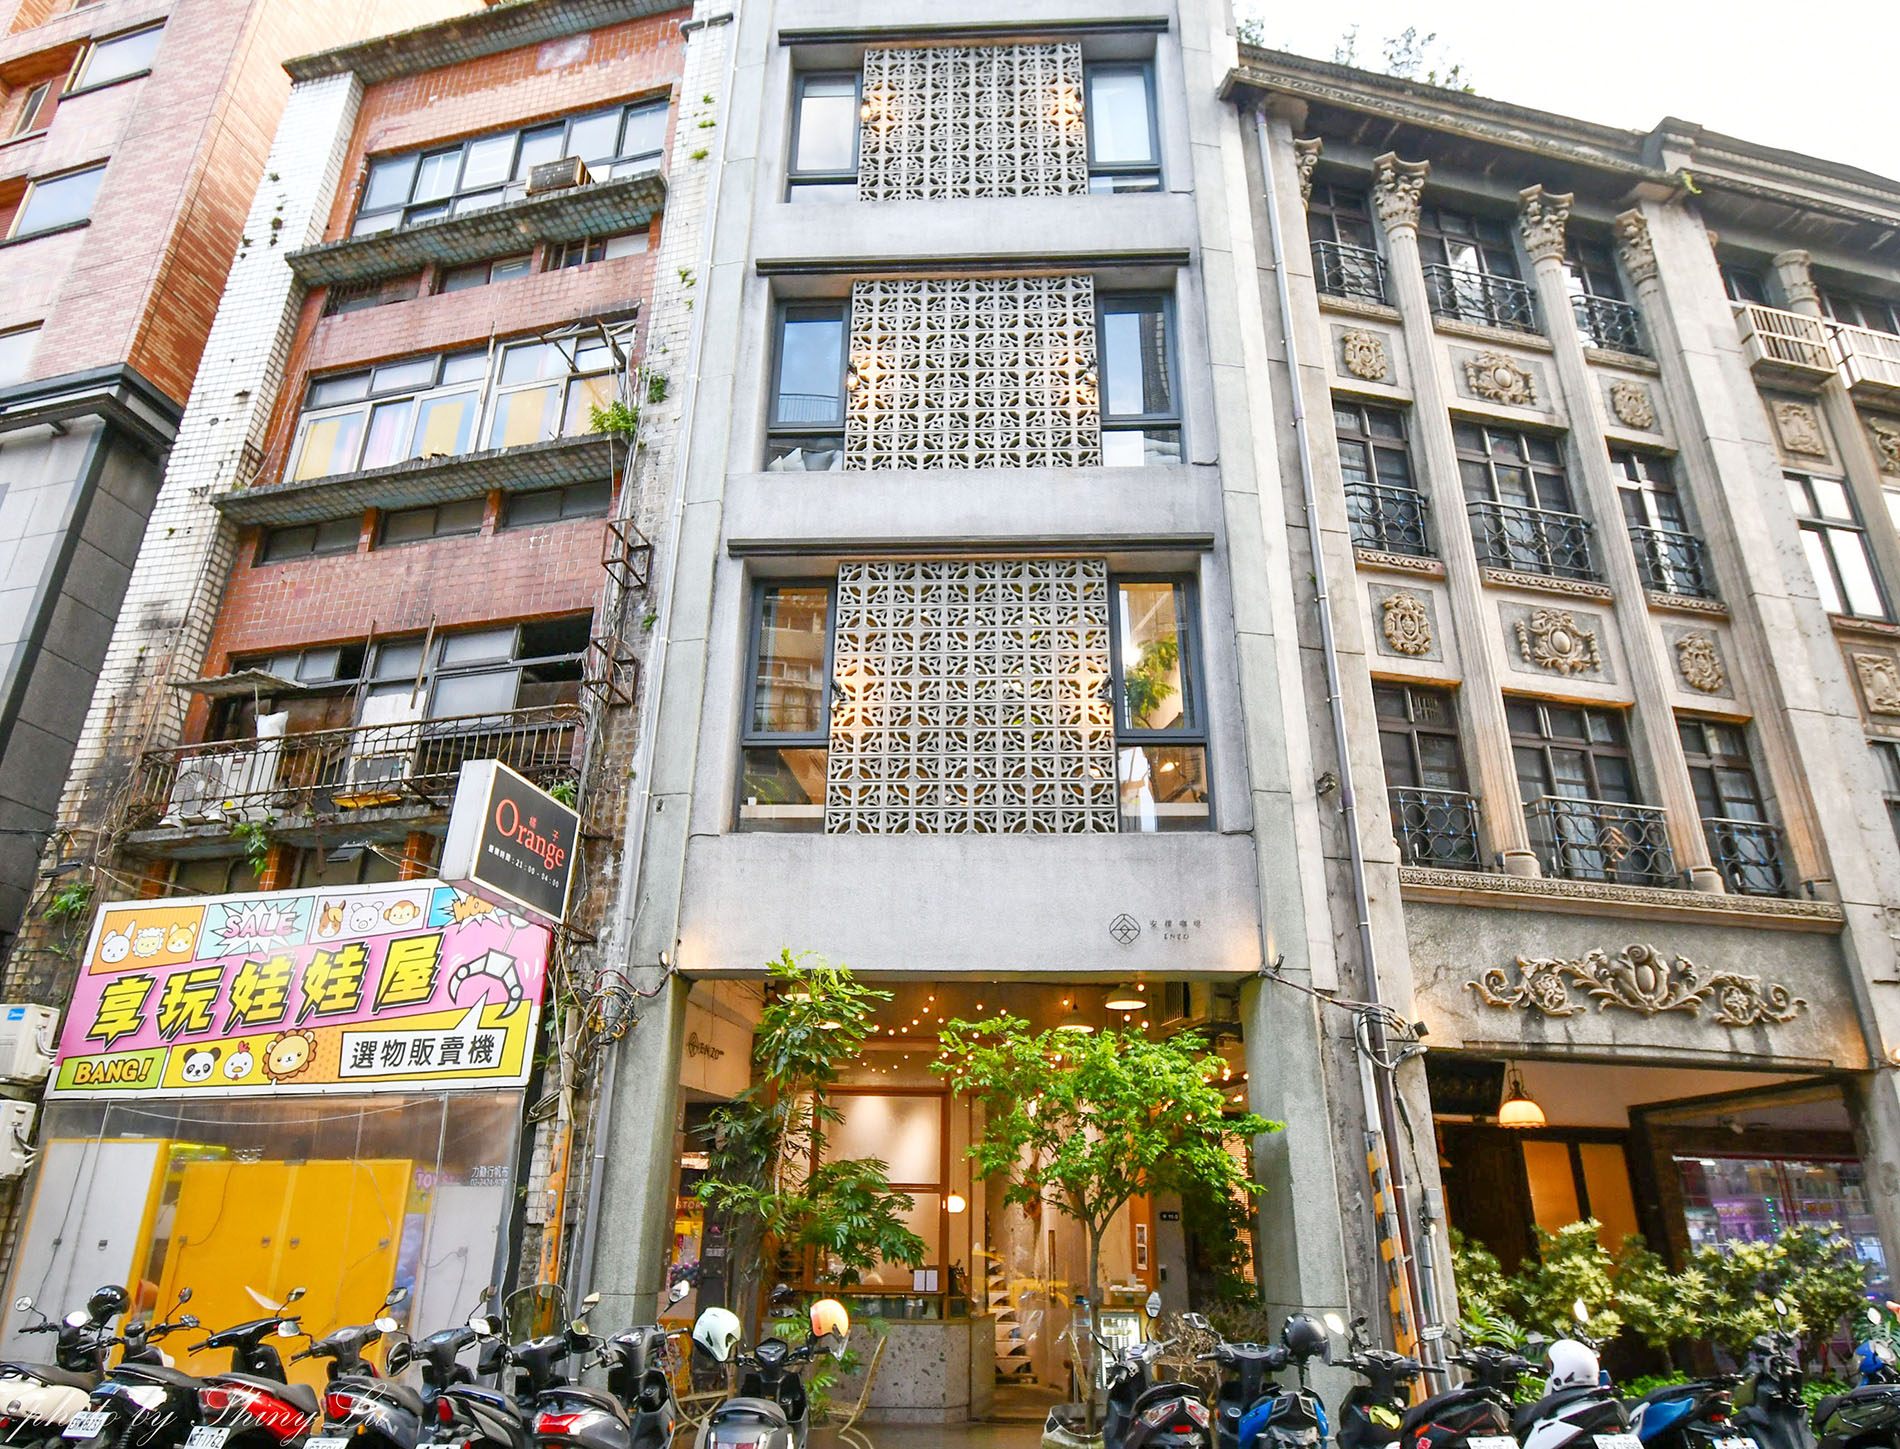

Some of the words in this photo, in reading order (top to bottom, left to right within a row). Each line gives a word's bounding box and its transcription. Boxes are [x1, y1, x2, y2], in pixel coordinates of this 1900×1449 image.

[495, 798, 565, 871] Orange
[223, 911, 297, 938] SALE
[84, 932, 446, 1050] 享玩娃娃屋
[349, 1034, 495, 1069] 選物販賣機
[73, 1058, 152, 1085] BANG!
